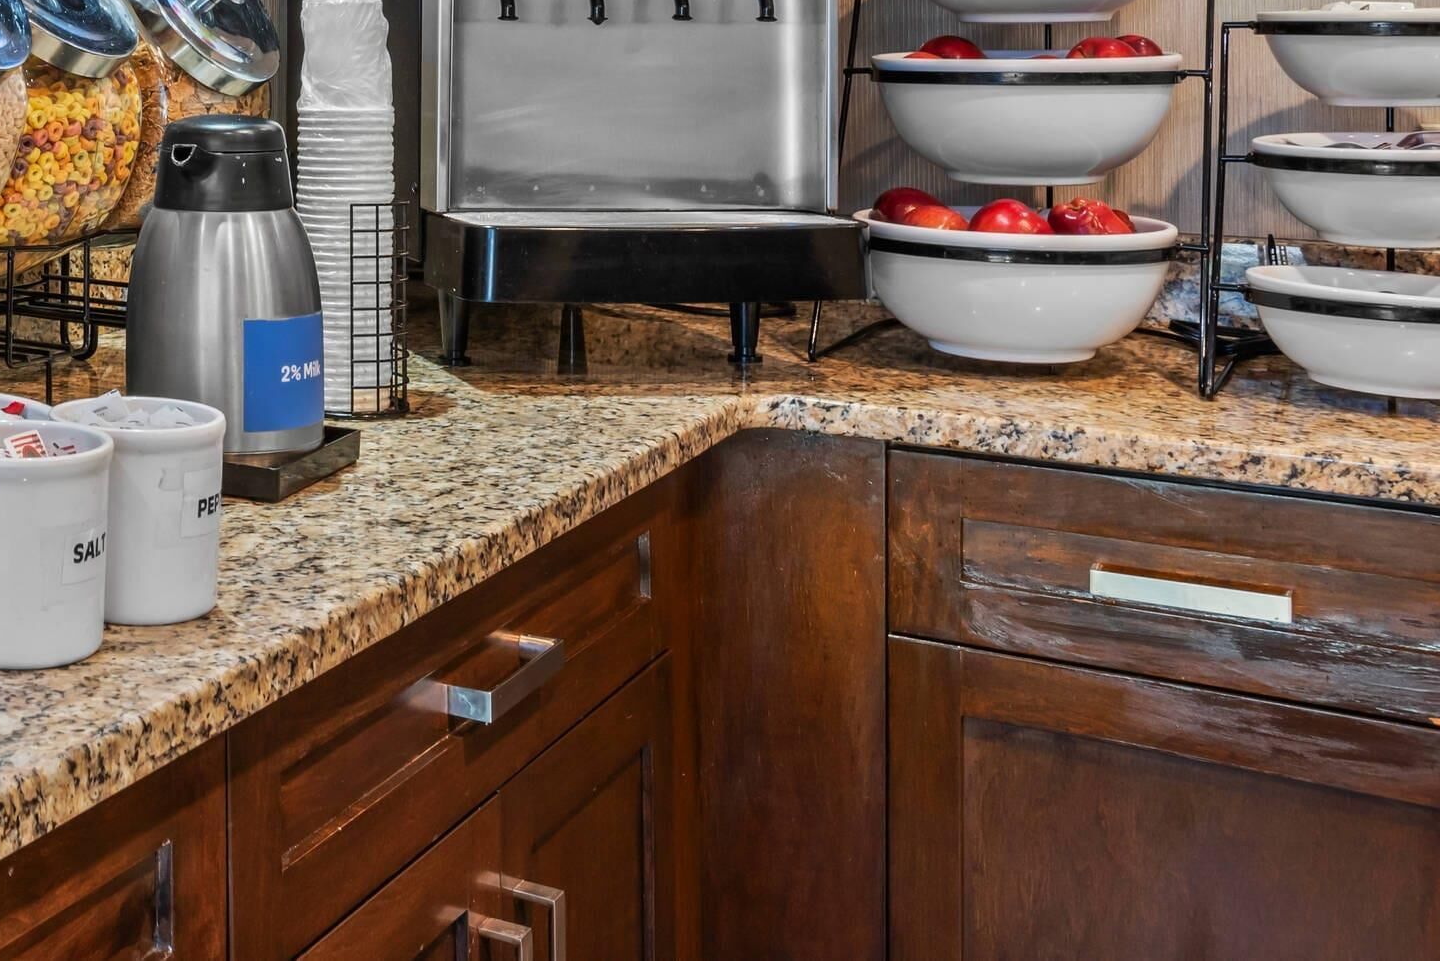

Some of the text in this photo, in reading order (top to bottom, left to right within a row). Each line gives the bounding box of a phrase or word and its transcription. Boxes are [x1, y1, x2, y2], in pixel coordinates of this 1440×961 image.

[281, 359, 321, 382] 2% Milk
[73, 531, 106, 564] SALT
